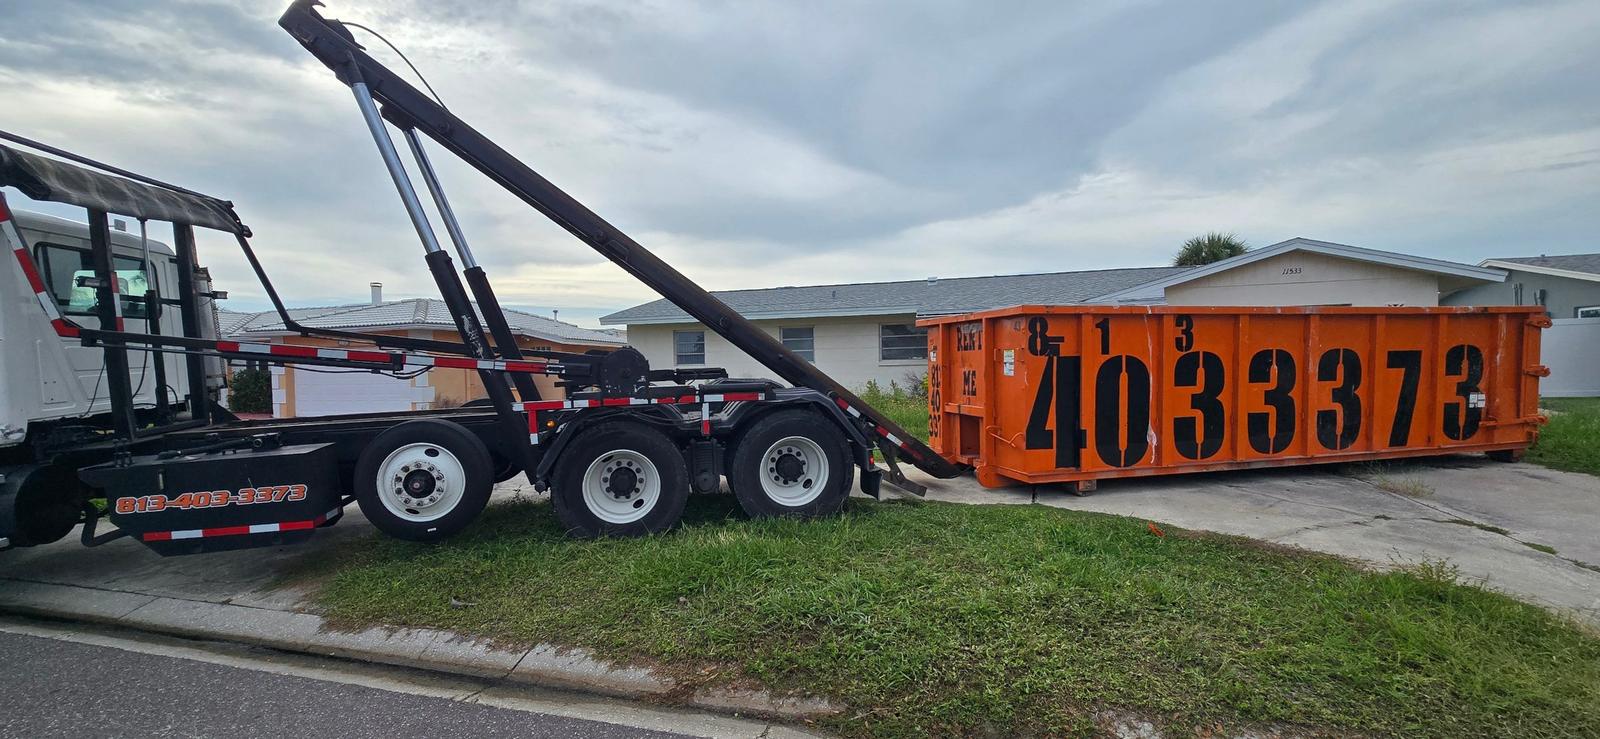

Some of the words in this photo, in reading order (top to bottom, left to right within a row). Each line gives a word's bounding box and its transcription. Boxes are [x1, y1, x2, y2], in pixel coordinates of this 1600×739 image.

[1281, 267, 1303, 275] 11533
[963, 370, 977, 396] ME
[115, 484, 307, 514] 813-403-3373
